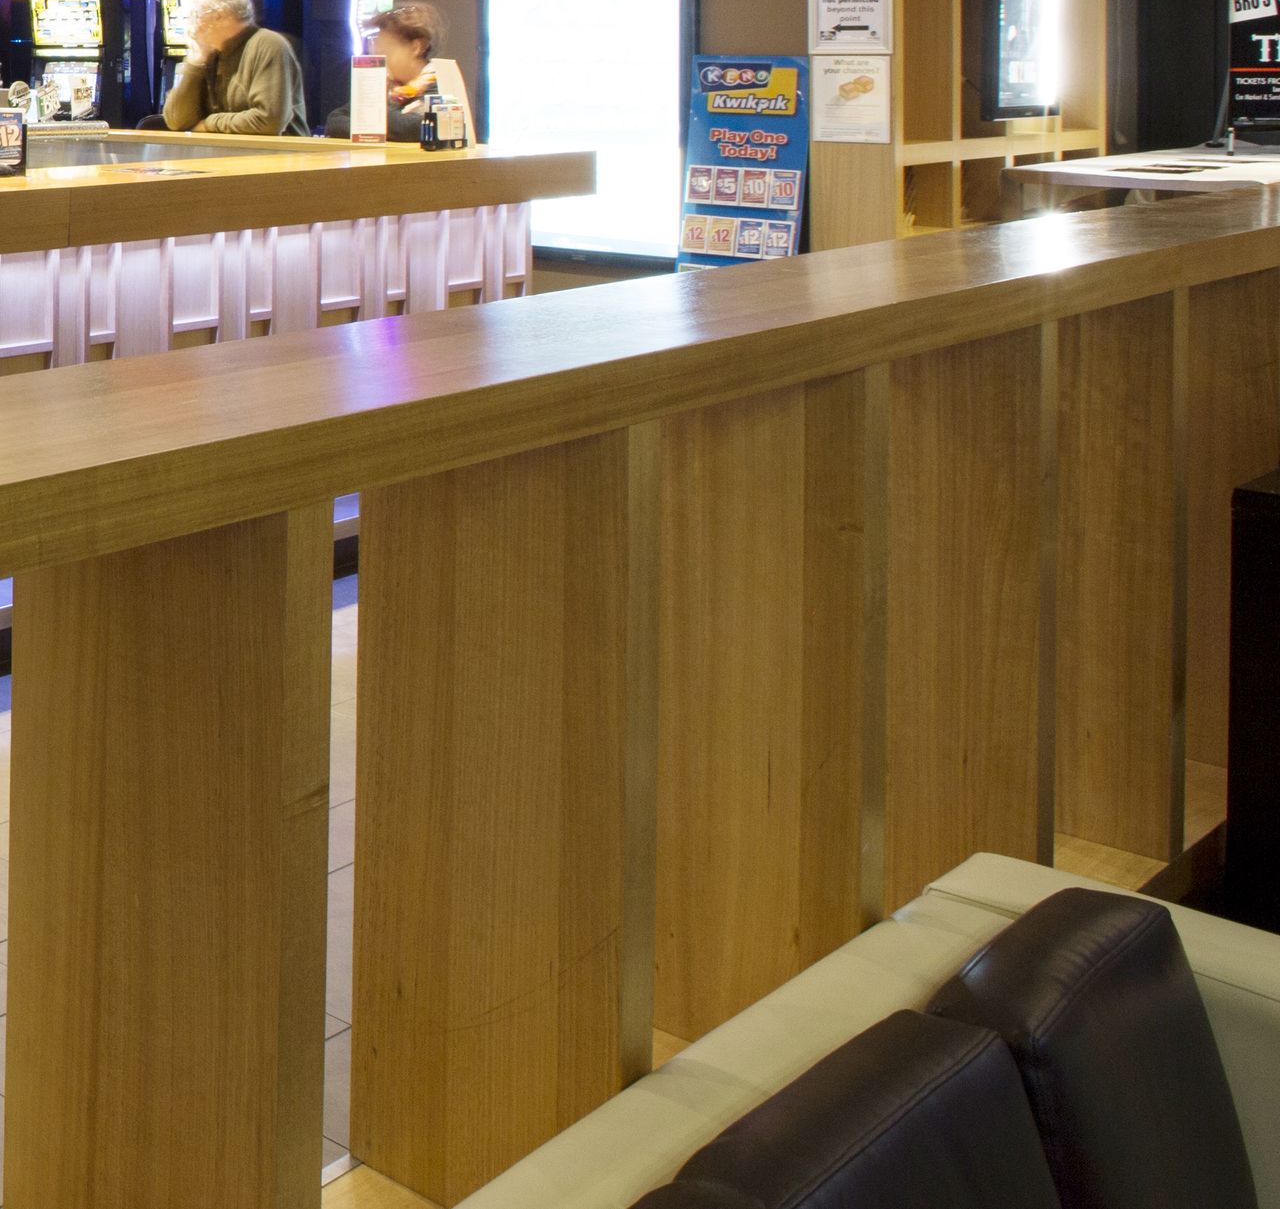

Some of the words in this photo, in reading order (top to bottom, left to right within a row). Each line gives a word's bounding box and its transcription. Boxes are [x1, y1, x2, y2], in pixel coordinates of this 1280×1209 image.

[707, 69, 769, 84] KENO
[1236, 77, 1267, 85] TICKETS
[712, 95, 788, 113] Kwikpik
[709, 129, 749, 144] Play
[750, 130, 788, 144] One
[719, 143, 777, 160] Today!
[717, 177, 737, 194] $5
[743, 178, 765, 195] $10
[740, 229, 760, 245] $12
[767, 233, 788, 248] $12
